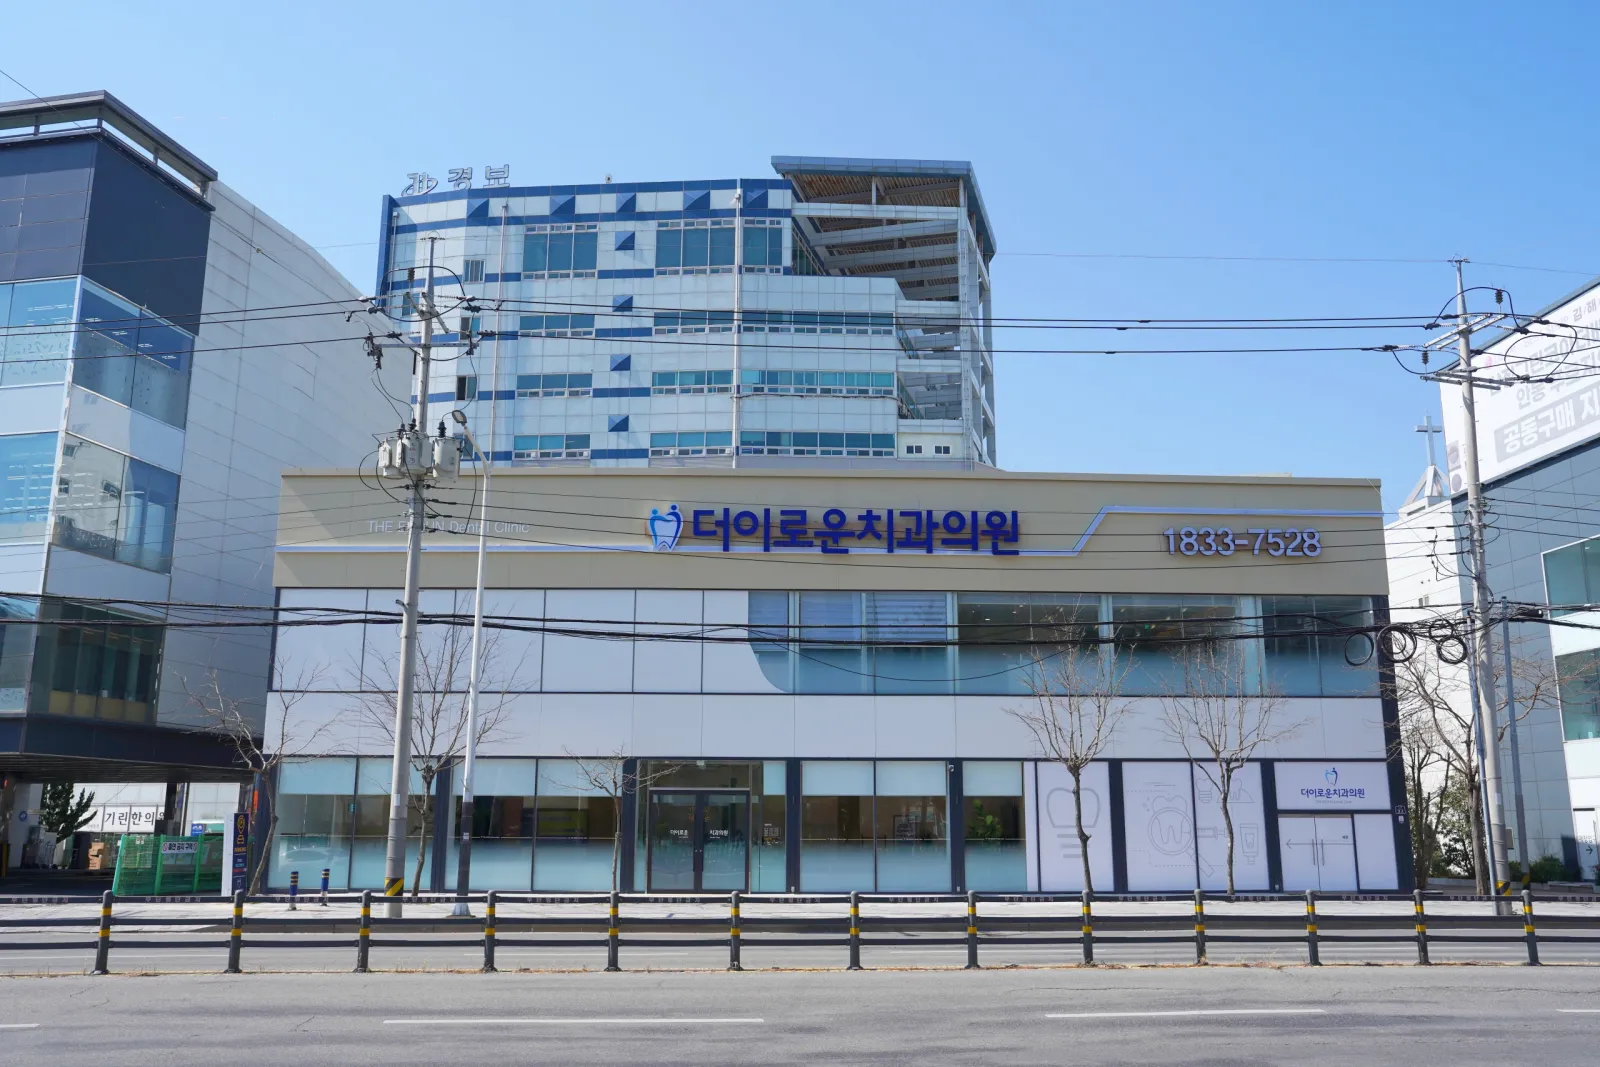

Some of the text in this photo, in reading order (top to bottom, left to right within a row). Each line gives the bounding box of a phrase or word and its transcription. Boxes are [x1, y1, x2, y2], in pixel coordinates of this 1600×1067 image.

[448, 164, 510, 190] 경보
[1504, 399, 1576, 453] 공동구매
[368, 520, 393, 533] THE
[398, 520, 445, 533] EUN
[494, 520, 530, 533] Clinic
[693, 507, 1020, 556] 더이로운치과의원
[1163, 526, 1322, 557] 1833-7528
[1300, 788, 1366, 799] 더이로운치과의원
